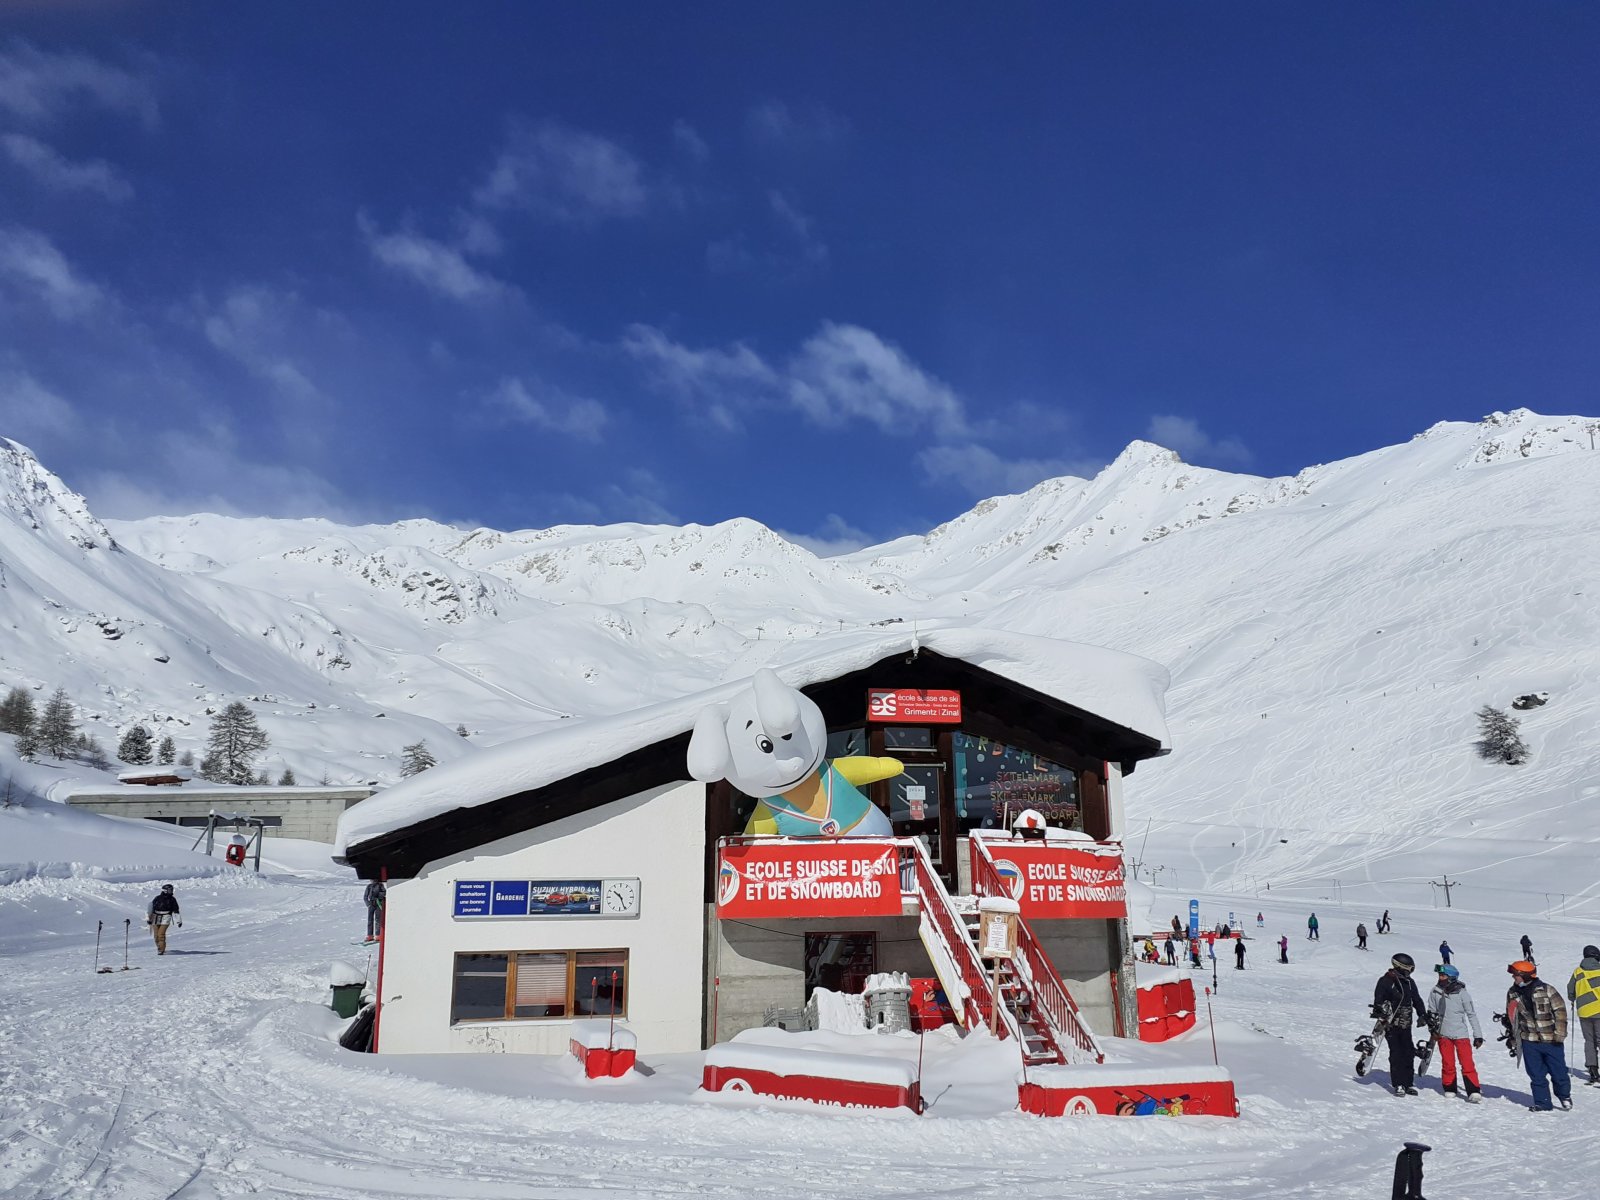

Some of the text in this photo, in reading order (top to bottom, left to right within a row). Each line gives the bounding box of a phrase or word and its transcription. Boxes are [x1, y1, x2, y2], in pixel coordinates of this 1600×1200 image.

[898, 694, 916, 702] école
[904, 708, 959, 717] Grimentz Zinal
[746, 860, 793, 878] ECOLE
[795, 859, 848, 878] SUISSE
[851, 859, 872, 876] DE
[875, 858, 897, 875] SKI
[1028, 863, 1067, 881] ECOLE
[532, 885, 600, 895] SUZUKI HYBRID 4x4
[745, 881, 882, 901] ET DE SNOWBOARD
[1030, 884, 1125, 902] ET DE SNOWBOARD
